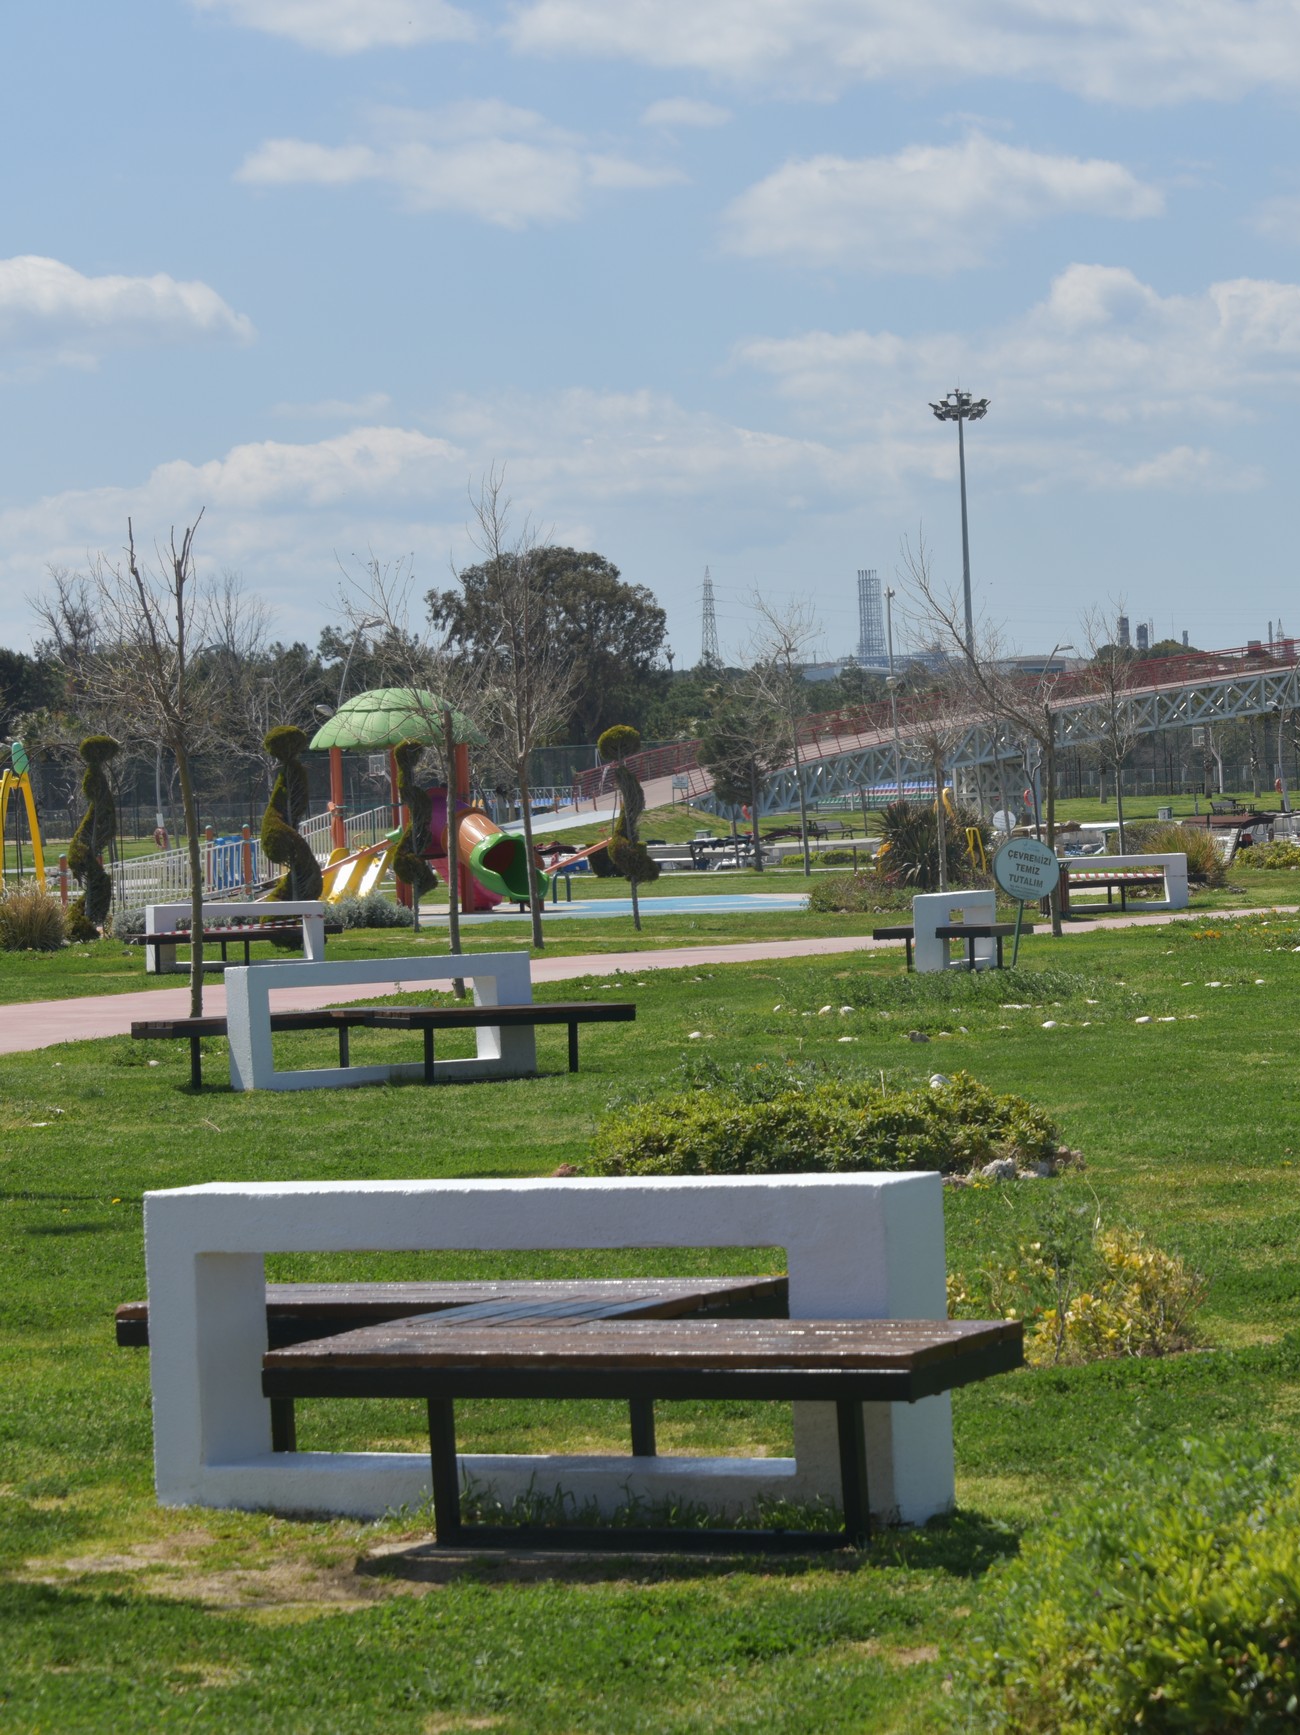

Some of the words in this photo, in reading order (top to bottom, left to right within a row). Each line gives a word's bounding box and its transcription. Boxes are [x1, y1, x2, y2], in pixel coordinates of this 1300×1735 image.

[1007, 849, 1052, 866] ÇEVREMİZİ
[1015, 863, 1041, 875] TEMİZ
[1008, 873, 1044, 888] TUTALIM
